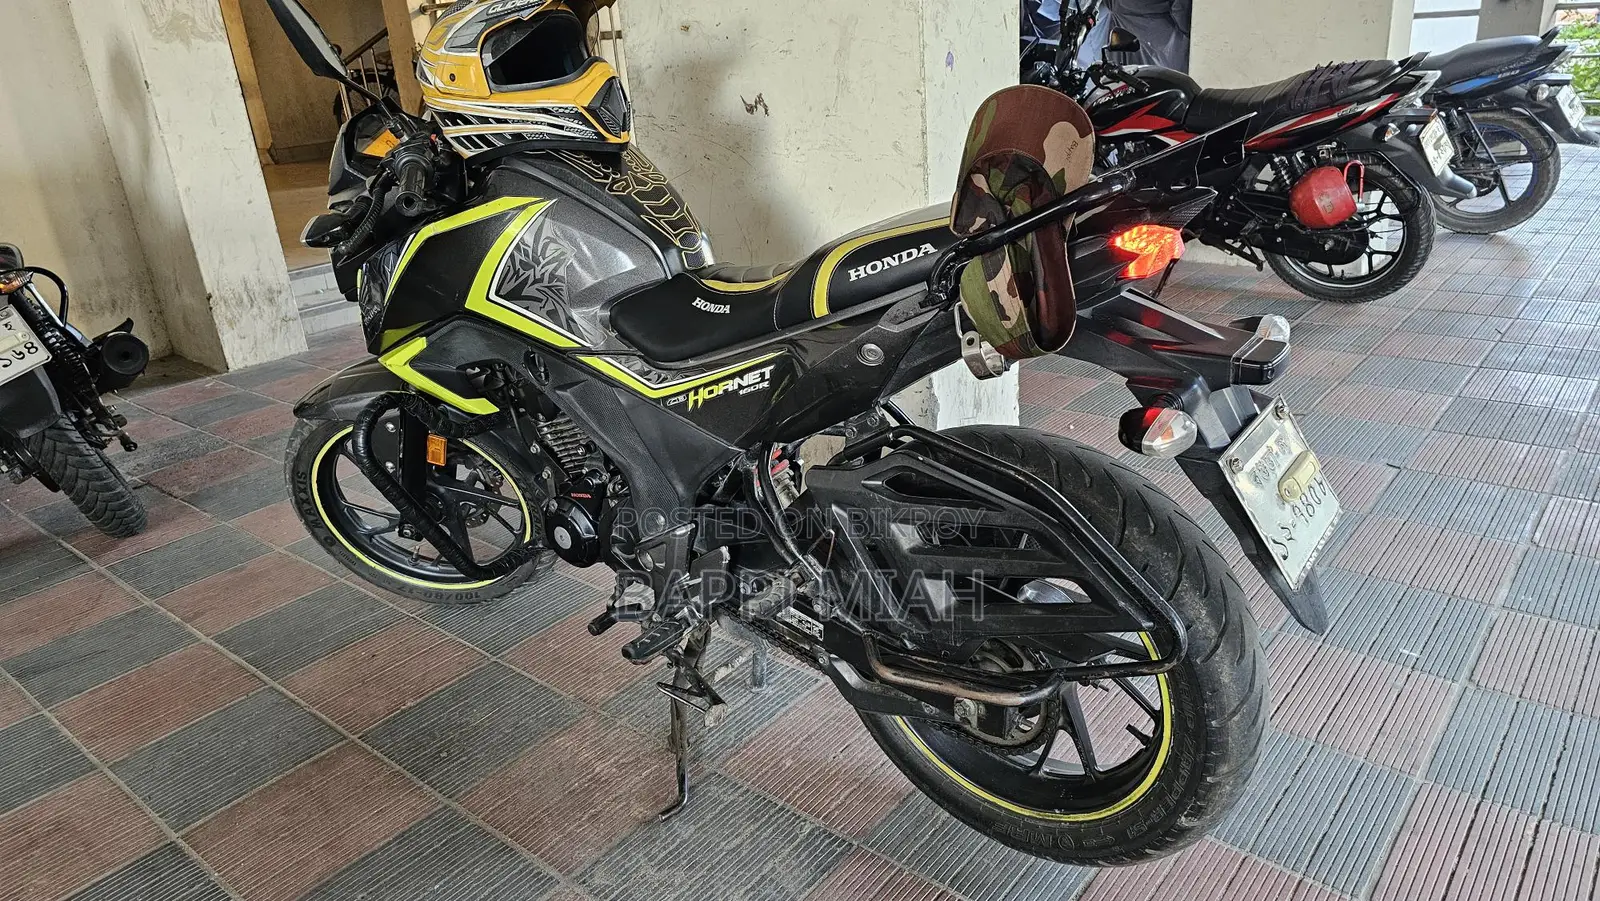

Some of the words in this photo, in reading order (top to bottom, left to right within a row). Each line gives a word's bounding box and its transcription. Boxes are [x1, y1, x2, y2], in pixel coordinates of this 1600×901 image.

[848, 242, 939, 282] HONDA
[691, 296, 731, 315] HONDA
[687, 364, 776, 412] HORNET
[738, 381, 770, 396] 160R
[295, 470, 326, 530] MAXXIS
